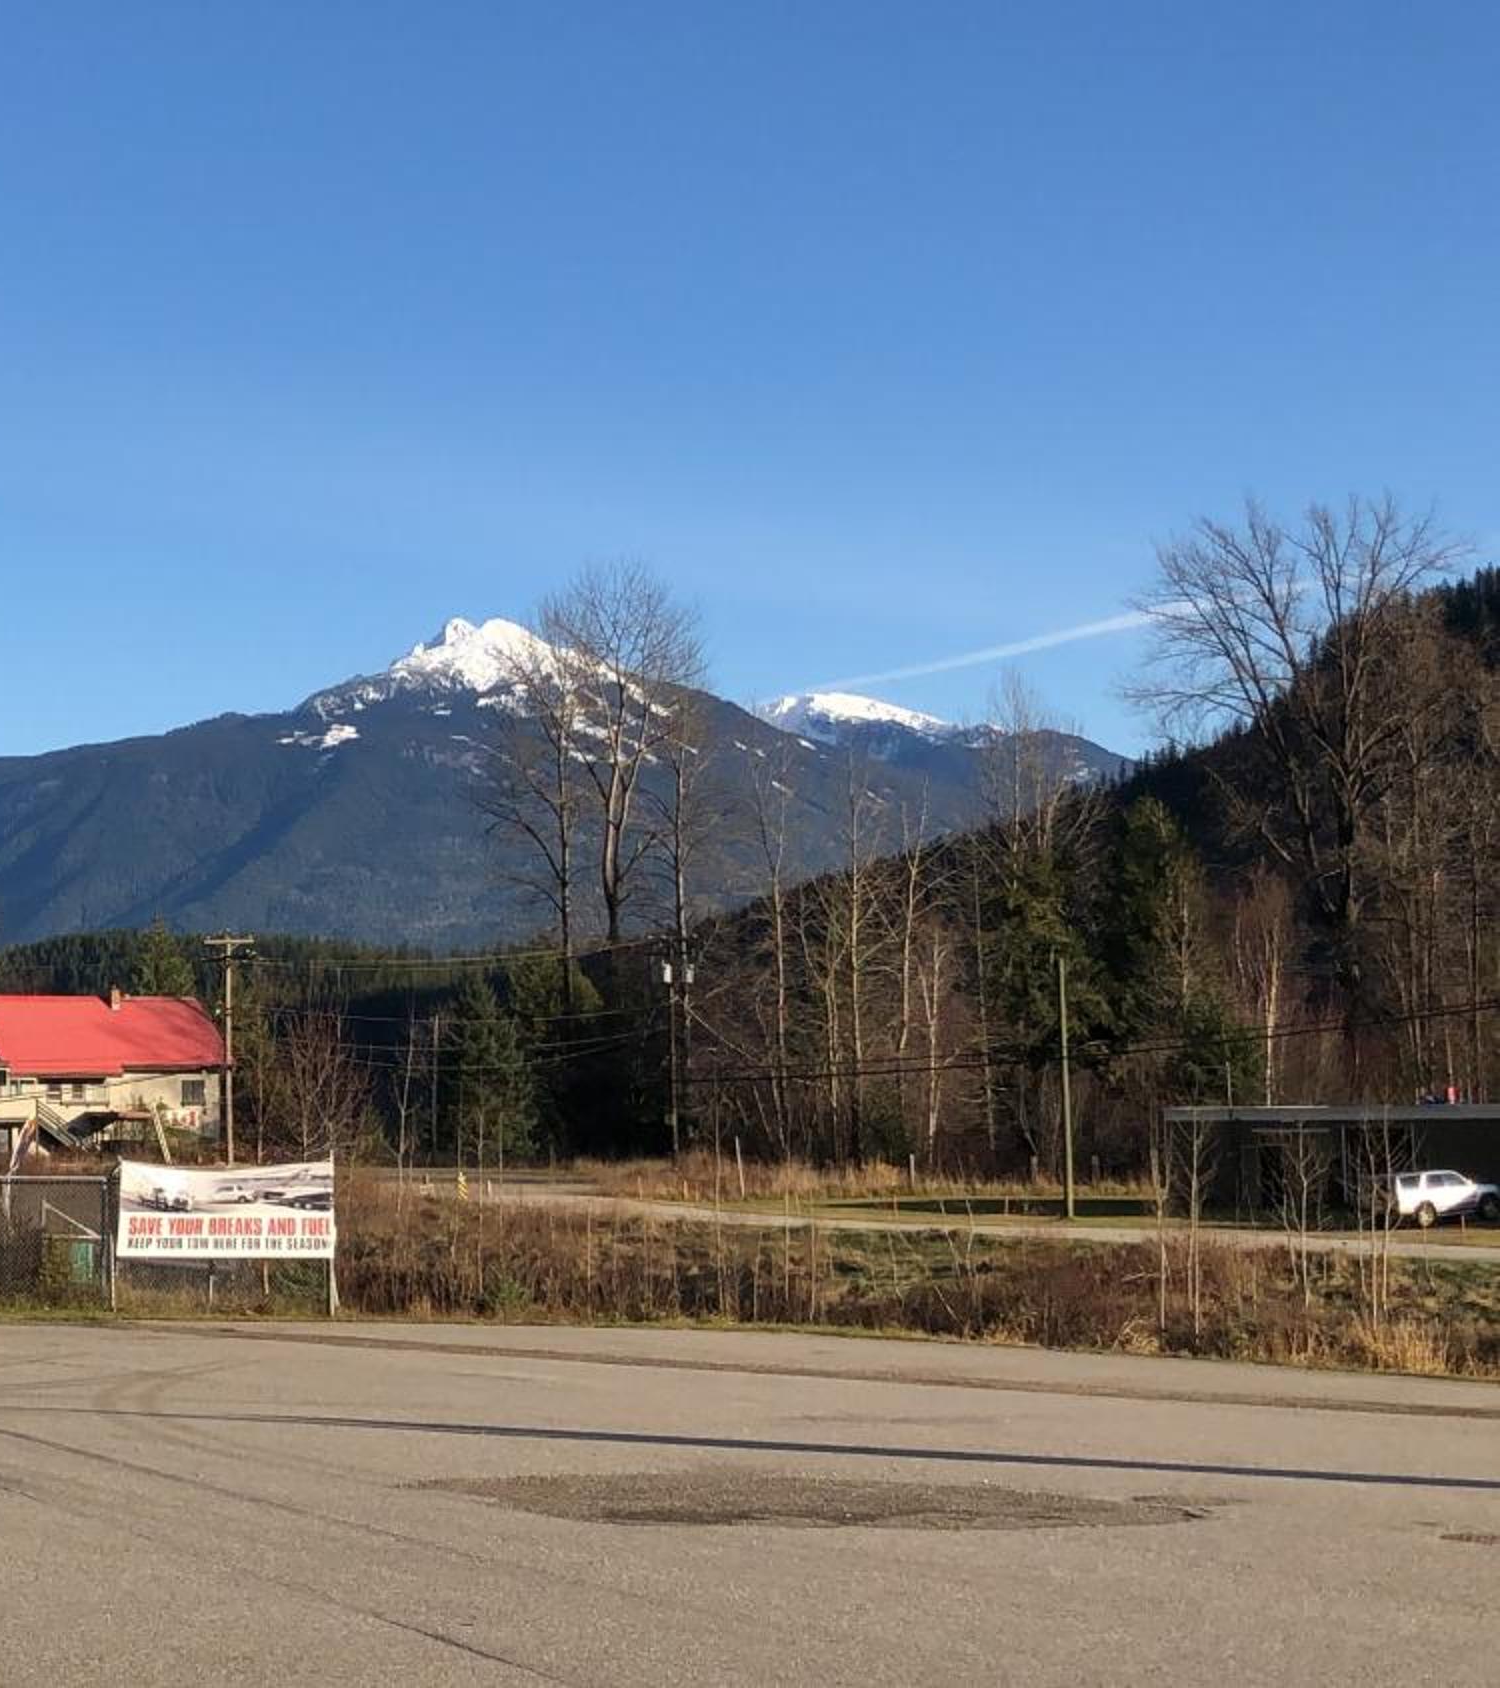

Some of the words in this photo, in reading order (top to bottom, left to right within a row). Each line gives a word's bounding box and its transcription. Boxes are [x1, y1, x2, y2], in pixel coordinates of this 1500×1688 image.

[128, 1216, 163, 1235] SAVE
[168, 1217, 203, 1235] YOUR
[208, 1217, 263, 1236] BREAKS
[267, 1217, 296, 1236] AND
[301, 1217, 331, 1236] FUEL
[127, 1237, 152, 1249] KEEP
[156, 1237, 183, 1249] YOUR
[213, 1237, 238, 1250] HERE
[241, 1237, 261, 1250] FOR
[265, 1237, 283, 1250] THE
